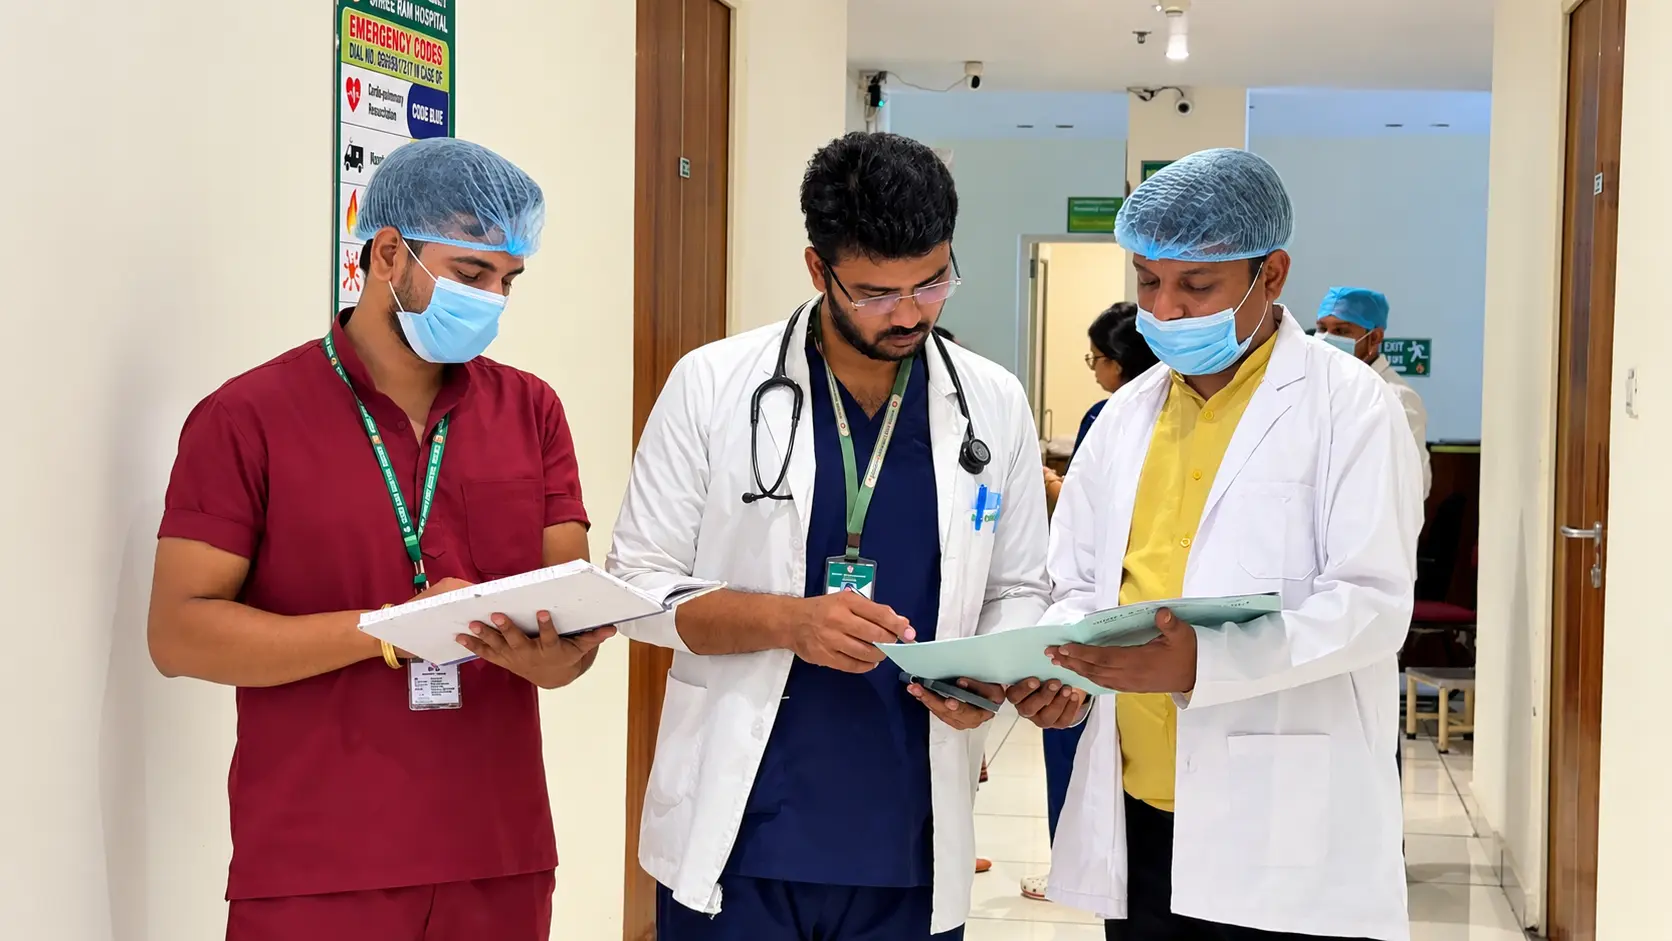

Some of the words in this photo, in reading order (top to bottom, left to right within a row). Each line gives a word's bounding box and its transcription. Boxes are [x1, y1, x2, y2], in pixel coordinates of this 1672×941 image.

[397, 0, 413, 20] RAM
[415, 5, 448, 33] HOSPITAL
[349, 14, 412, 55] EMERGENCY
[414, 37, 442, 65] CODES
[349, 42, 363, 61] DIAL
[421, 65, 434, 83] CASE
[412, 103, 428, 122] CODE
[430, 108, 443, 125] BLUE
[1384, 341, 1405, 353] EXIT
